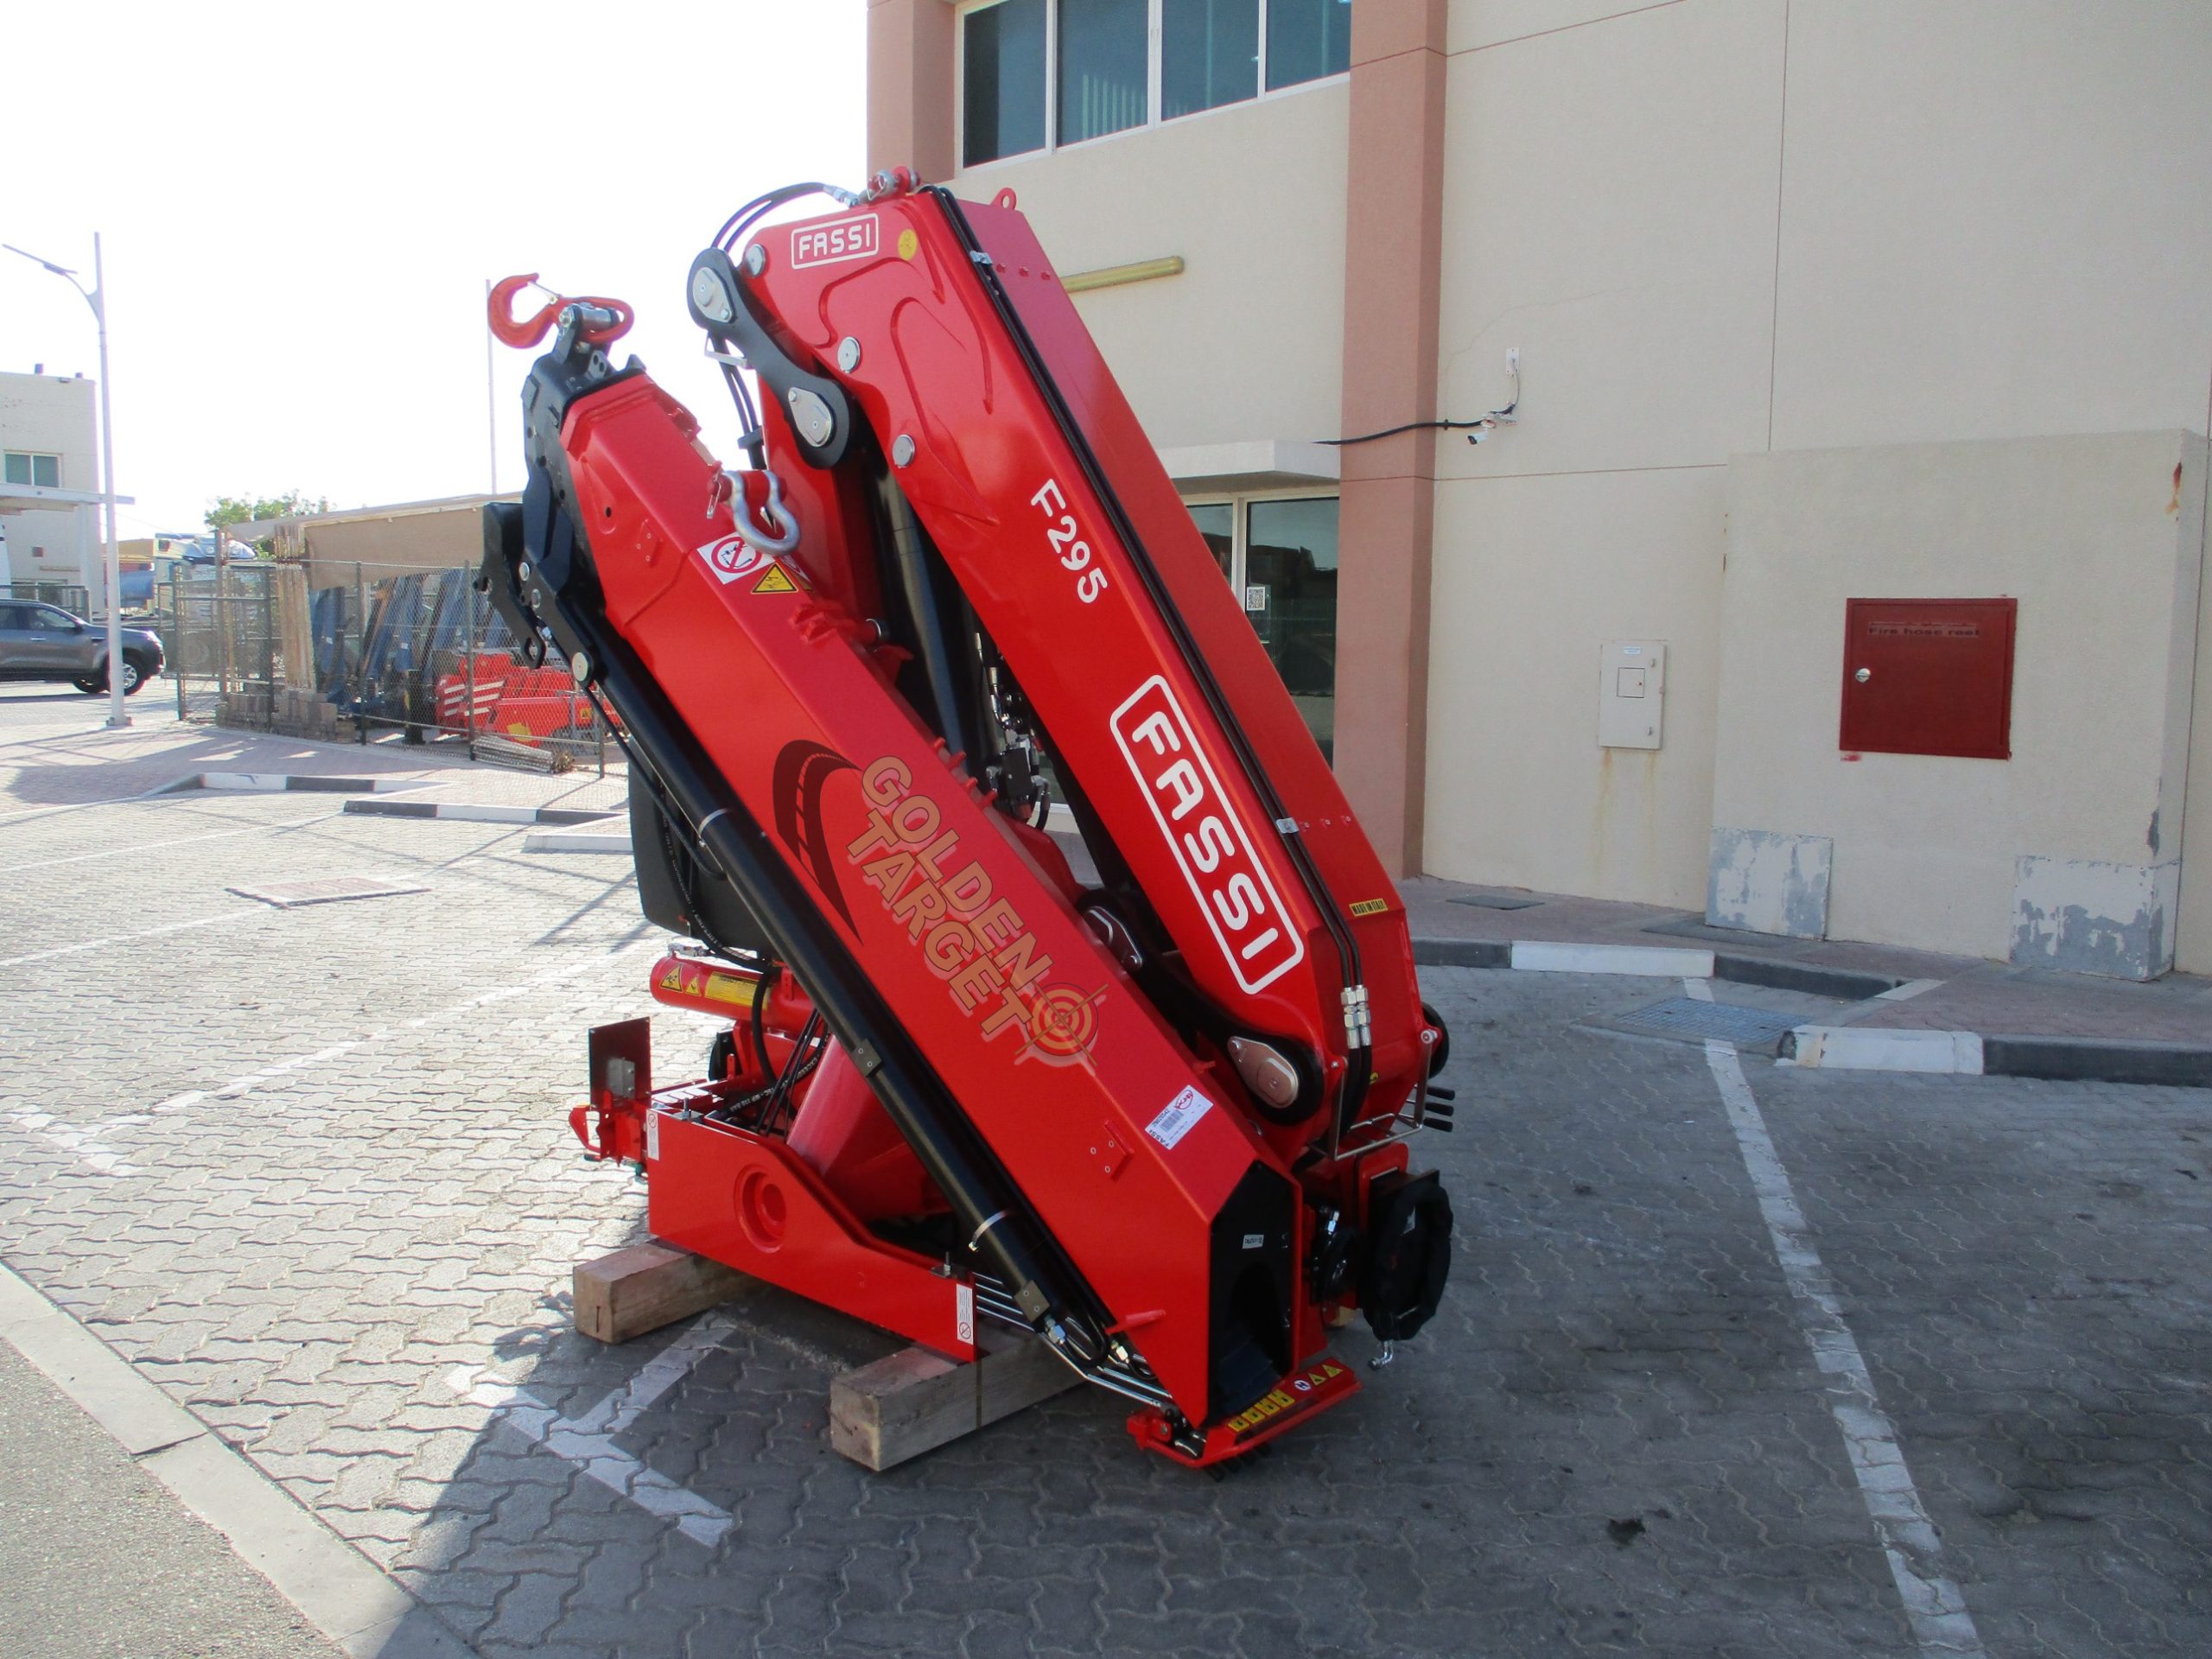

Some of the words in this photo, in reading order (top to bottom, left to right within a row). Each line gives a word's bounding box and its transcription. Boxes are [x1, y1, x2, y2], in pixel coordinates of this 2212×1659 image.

[798, 223, 871, 259] FASSI
[1030, 478, 1109, 604] F295
[1904, 627, 1942, 636] hose
[1948, 628, 1980, 637] reel
[846, 807, 1034, 1036] TARGET
[861, 755, 1055, 992] GOLDEN
[1131, 710, 1279, 961] FASSI
